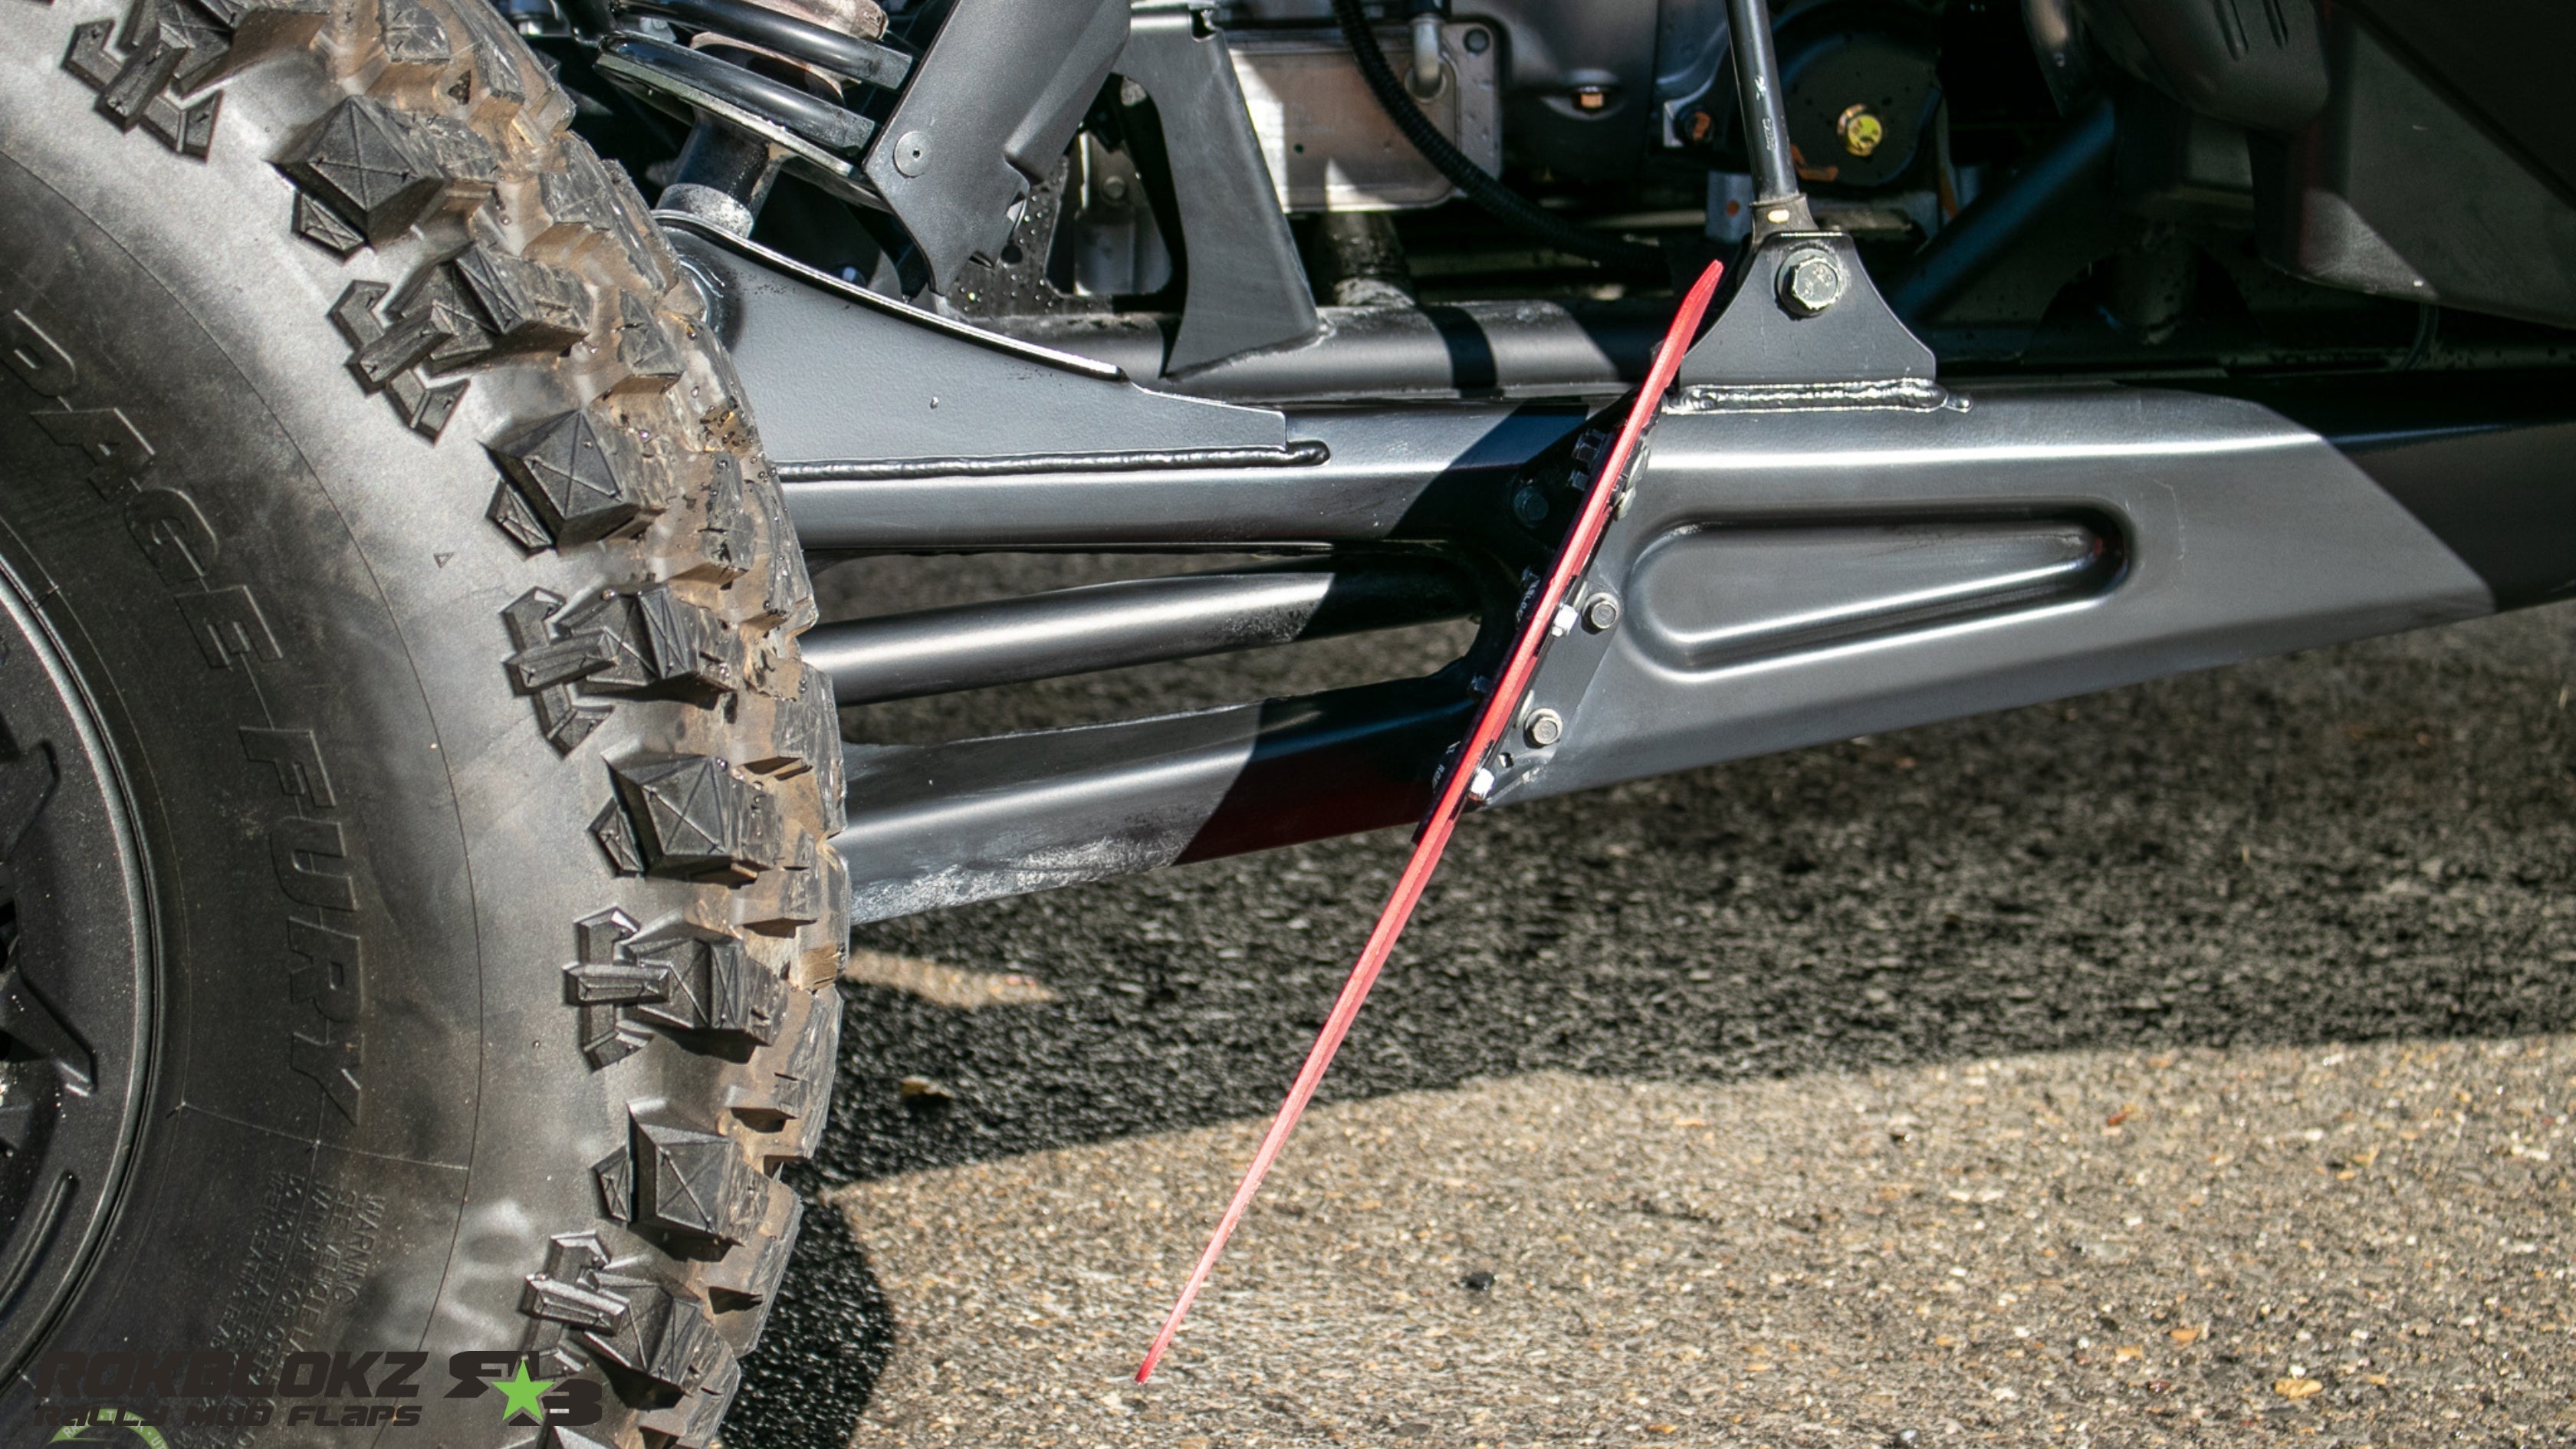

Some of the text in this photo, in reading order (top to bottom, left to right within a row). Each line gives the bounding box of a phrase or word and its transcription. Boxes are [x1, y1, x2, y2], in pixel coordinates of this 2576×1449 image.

[238, 725, 365, 1127] FURY
[296, 1187, 357, 1325] SEE VEHICLE
[330, 1191, 386, 1306] WARNING
